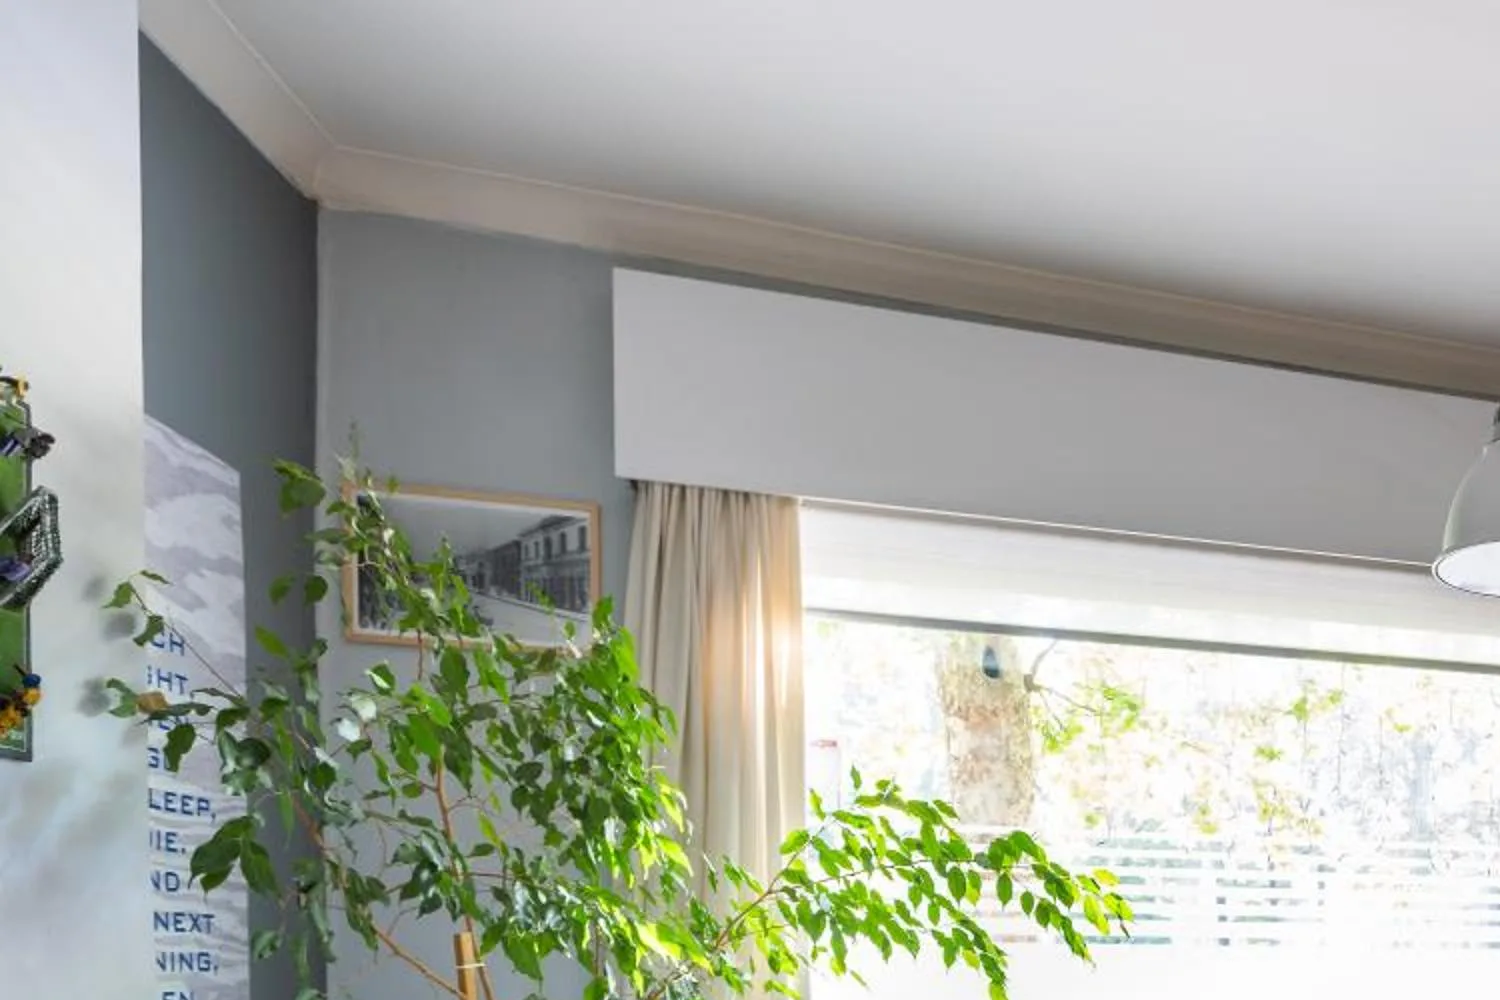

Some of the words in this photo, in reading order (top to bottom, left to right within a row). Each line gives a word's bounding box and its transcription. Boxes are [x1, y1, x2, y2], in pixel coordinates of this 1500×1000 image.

[151, 630, 185, 656] CH
[147, 665, 194, 698] HT,
[149, 787, 217, 823] LEEP,
[149, 830, 186, 855] IE.
[150, 871, 181, 892] ND
[153, 911, 215, 933] NEXT
[156, 952, 219, 976] NING,
